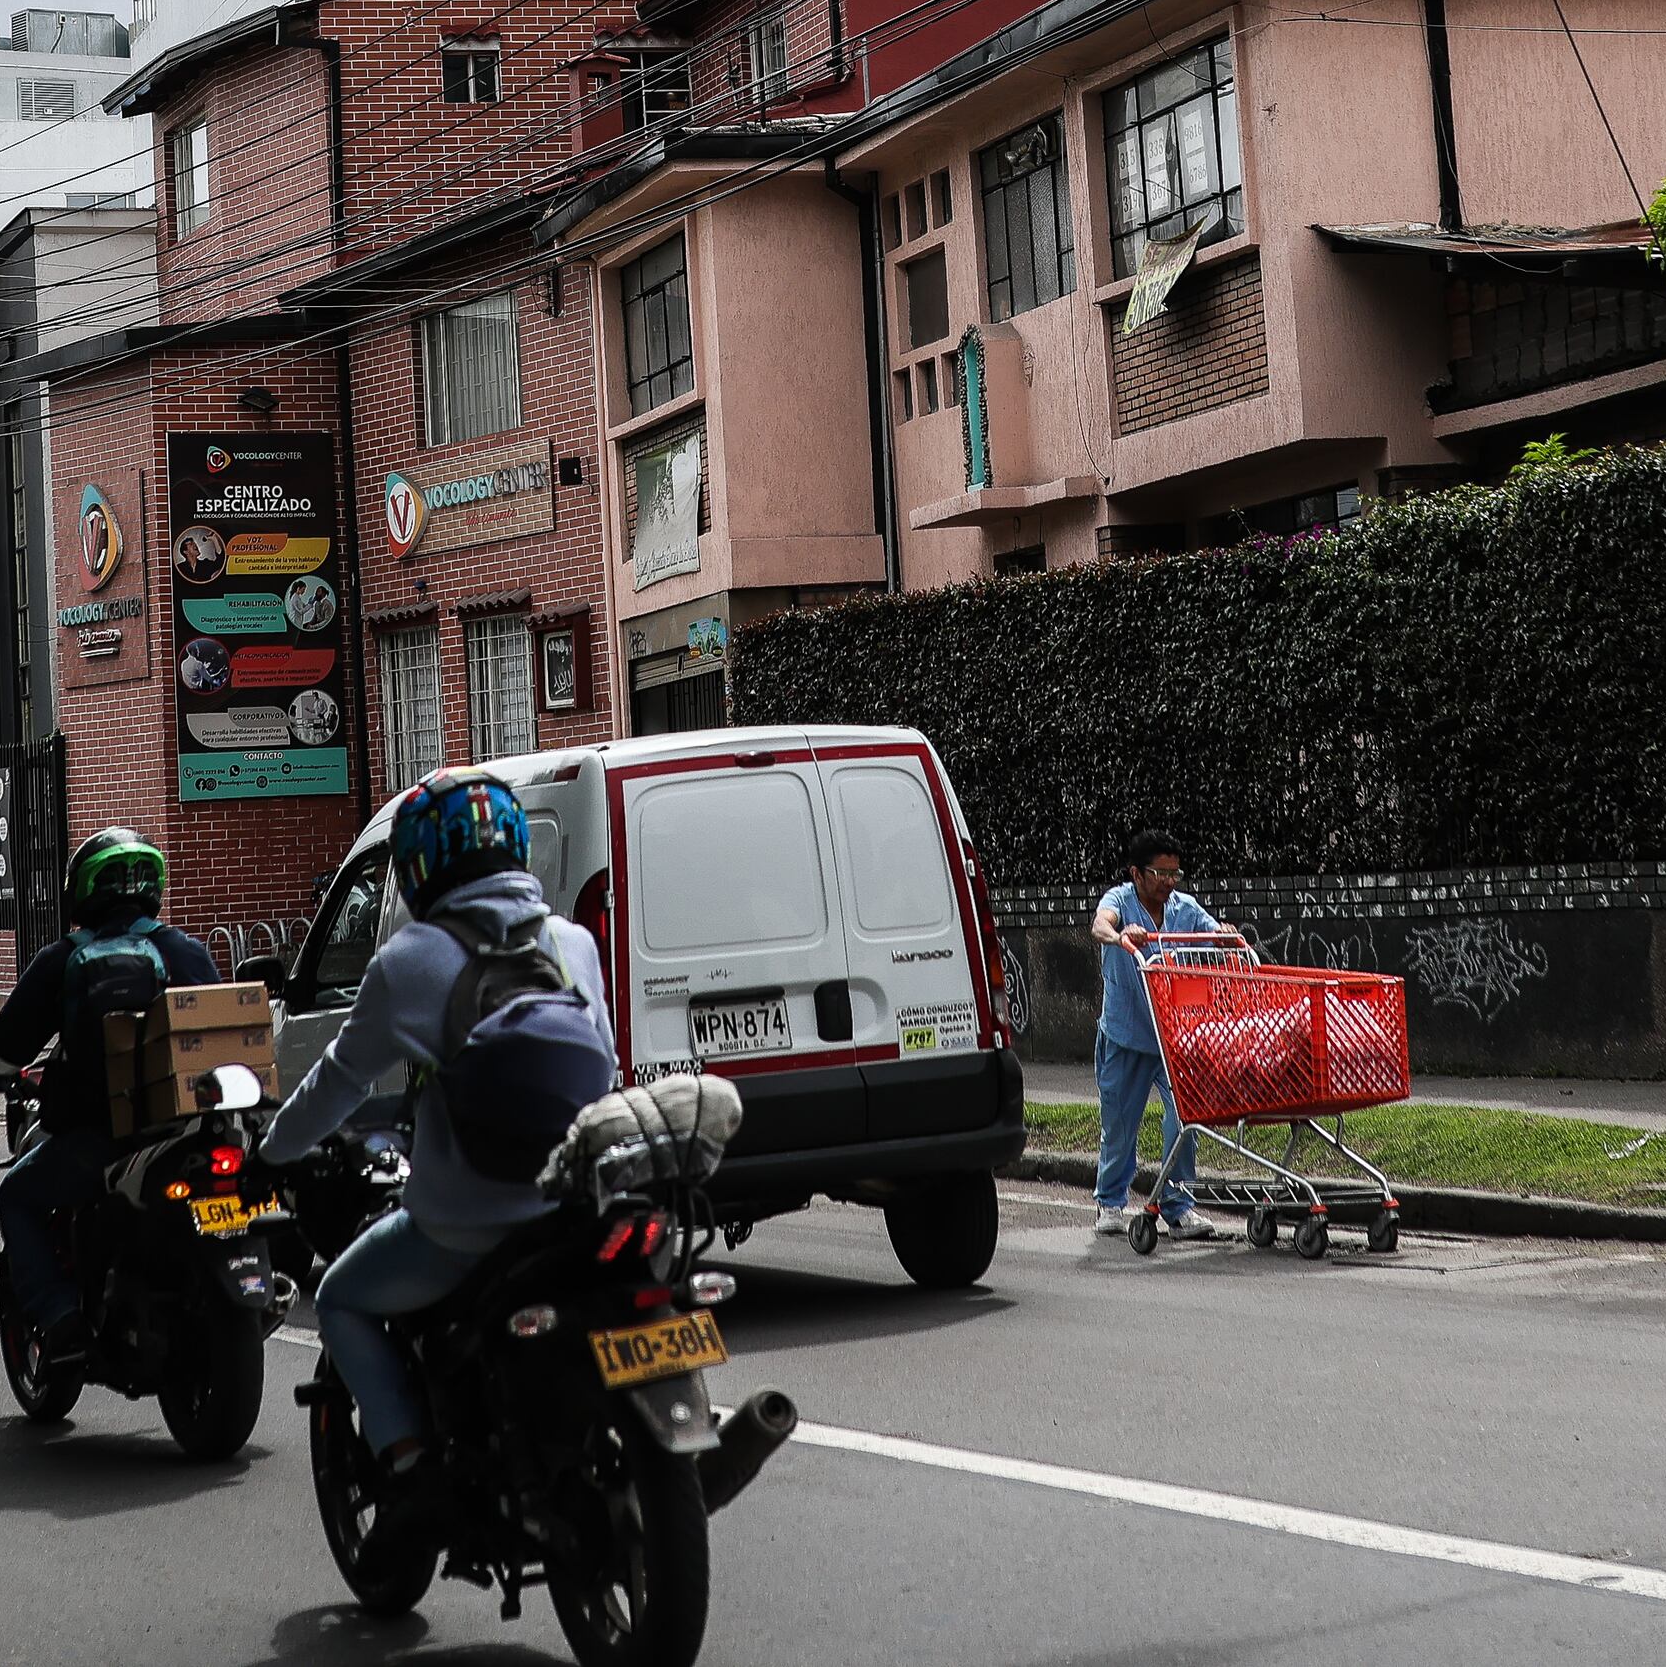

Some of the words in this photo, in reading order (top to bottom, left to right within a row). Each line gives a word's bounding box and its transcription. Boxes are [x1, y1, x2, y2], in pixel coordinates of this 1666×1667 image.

[224, 485, 283, 498] CENTRO
[196, 499, 312, 512] ESPECIALIZADO
[243, 752, 283, 761] CONTACTO
[900, 1017, 938, 1027] MARQUE
